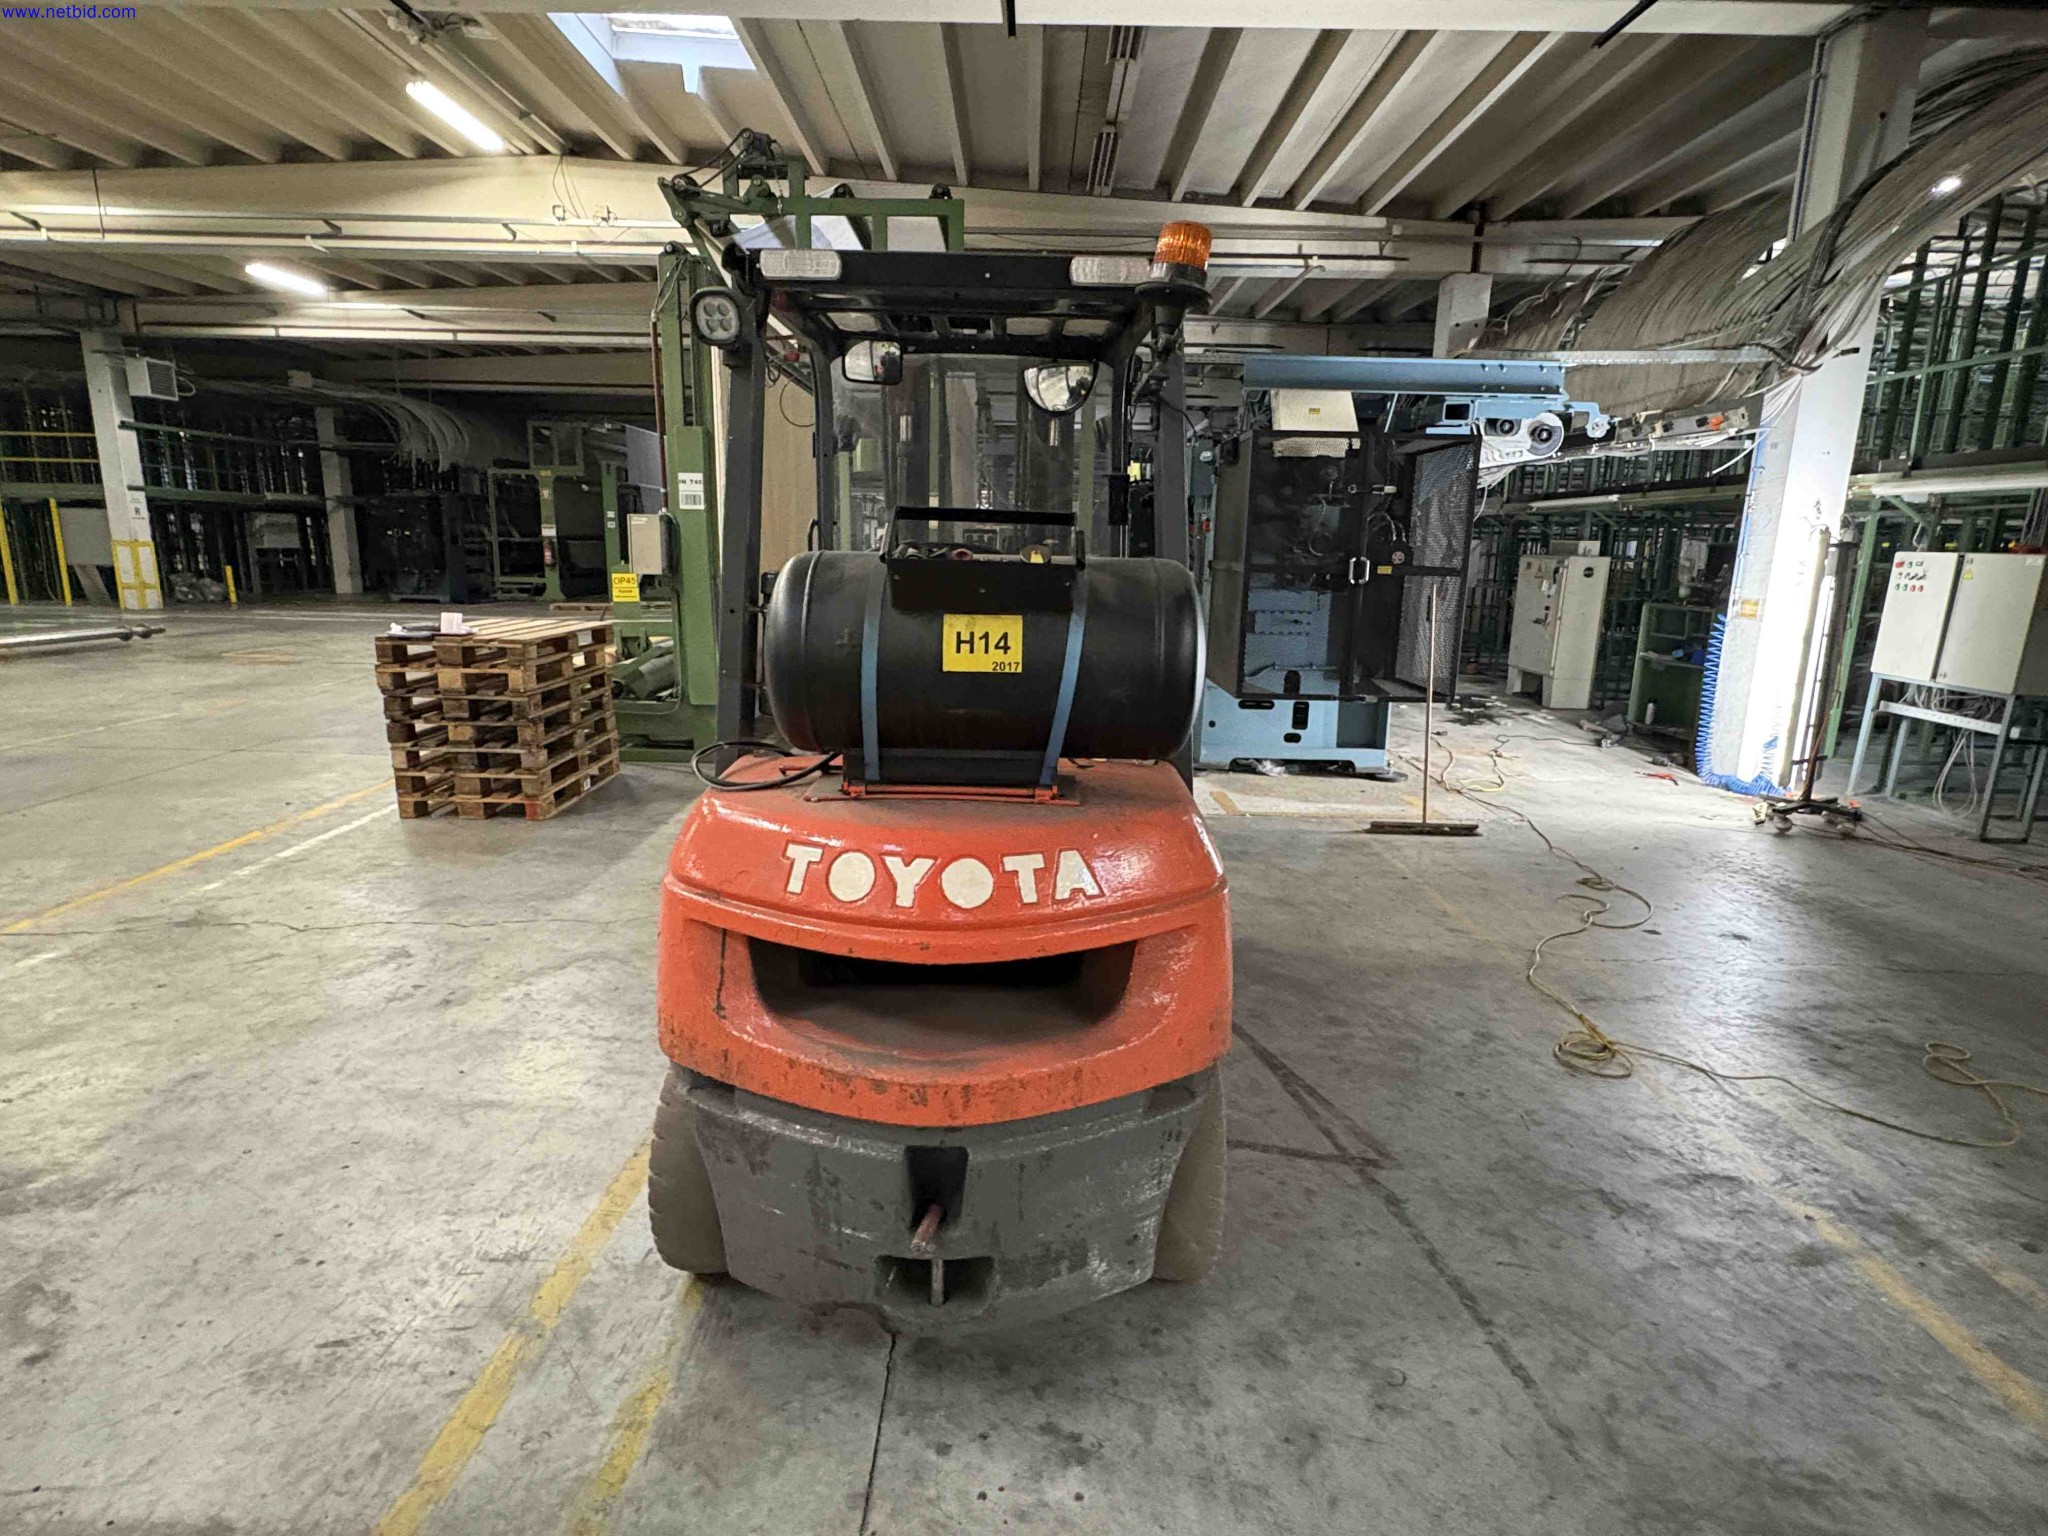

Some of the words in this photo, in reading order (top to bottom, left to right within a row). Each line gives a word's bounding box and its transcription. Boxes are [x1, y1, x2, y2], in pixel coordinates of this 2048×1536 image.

[613, 576, 636, 585] OP45
[955, 631, 1011, 655] H14
[991, 661, 1020, 672] 2017
[783, 842, 1104, 910] TOYOTA
